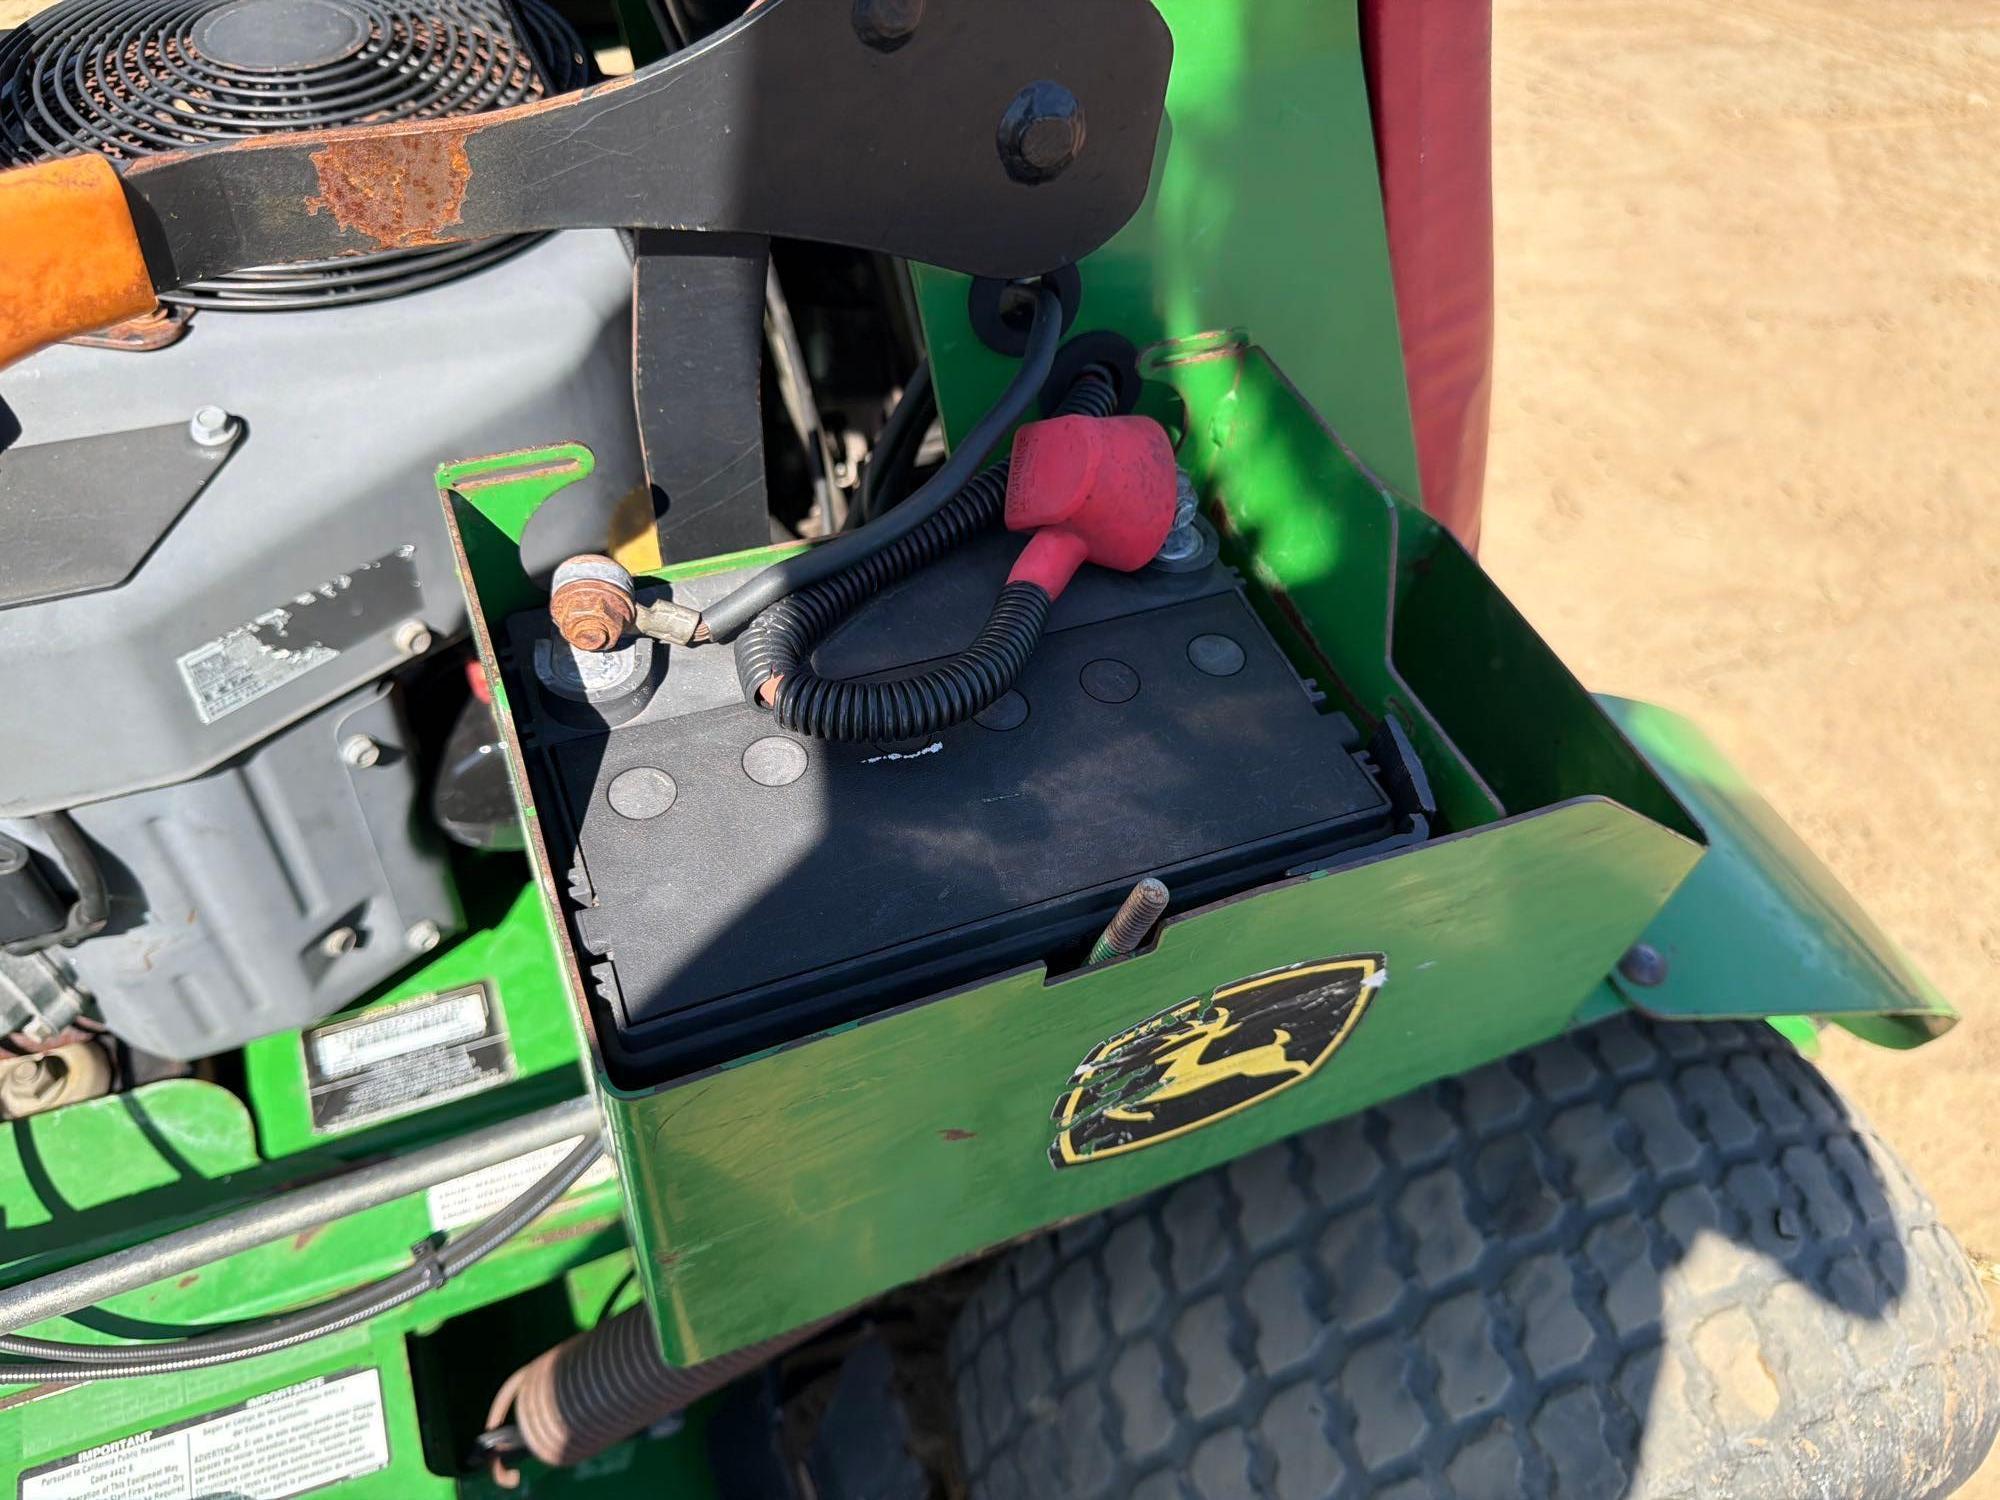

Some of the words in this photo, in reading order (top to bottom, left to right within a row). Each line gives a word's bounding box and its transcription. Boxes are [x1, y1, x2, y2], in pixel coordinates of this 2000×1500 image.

[78, 1431, 152, 1463] IMPORTANT
[41, 1470, 73, 1487] Pursuant
[82, 1458, 115, 1475] California
[118, 1451, 139, 1463] Public
[141, 1439, 175, 1455] Resources
[91, 1474, 108, 1486] Code
[111, 1480, 125, 1492] This
[127, 1470, 162, 1486] Equipment
[164, 1464, 179, 1475] May
[129, 1485, 145, 1497] Fires
[147, 1475, 172, 1492] Around
[173, 1473, 184, 1485] Dry
